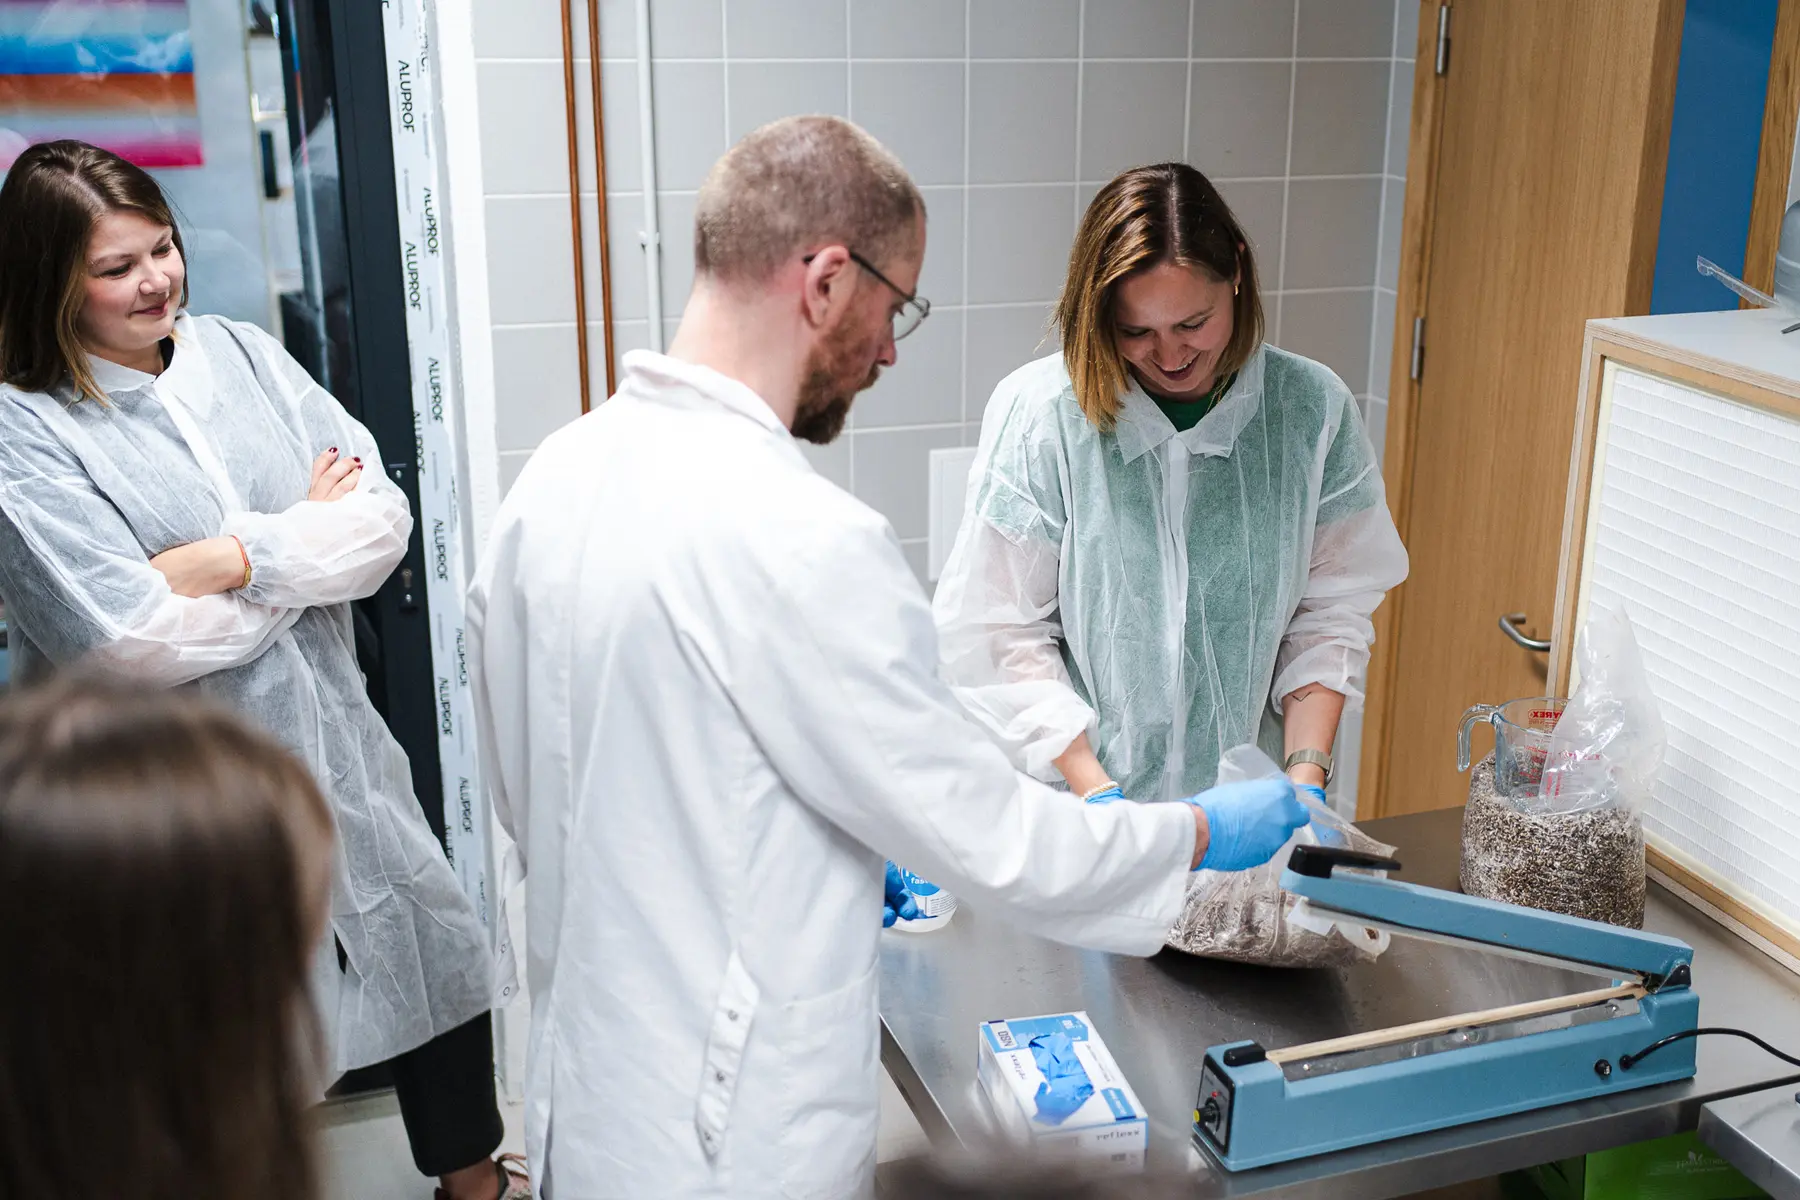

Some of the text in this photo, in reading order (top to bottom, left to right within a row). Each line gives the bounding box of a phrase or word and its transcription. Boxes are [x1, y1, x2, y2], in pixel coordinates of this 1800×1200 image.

[398, 59, 415, 134] ALUPROF
[423, 187, 439, 258] ALUPROF
[405, 241, 421, 312] ALUPROF
[428, 357, 443, 424] ALUPROF
[433, 518, 448, 582] ALUPROF
[438, 676, 453, 737] ALUPROF
[460, 776, 474, 836] ALUPROF
[1096, 1130, 1140, 1141] reflexx
